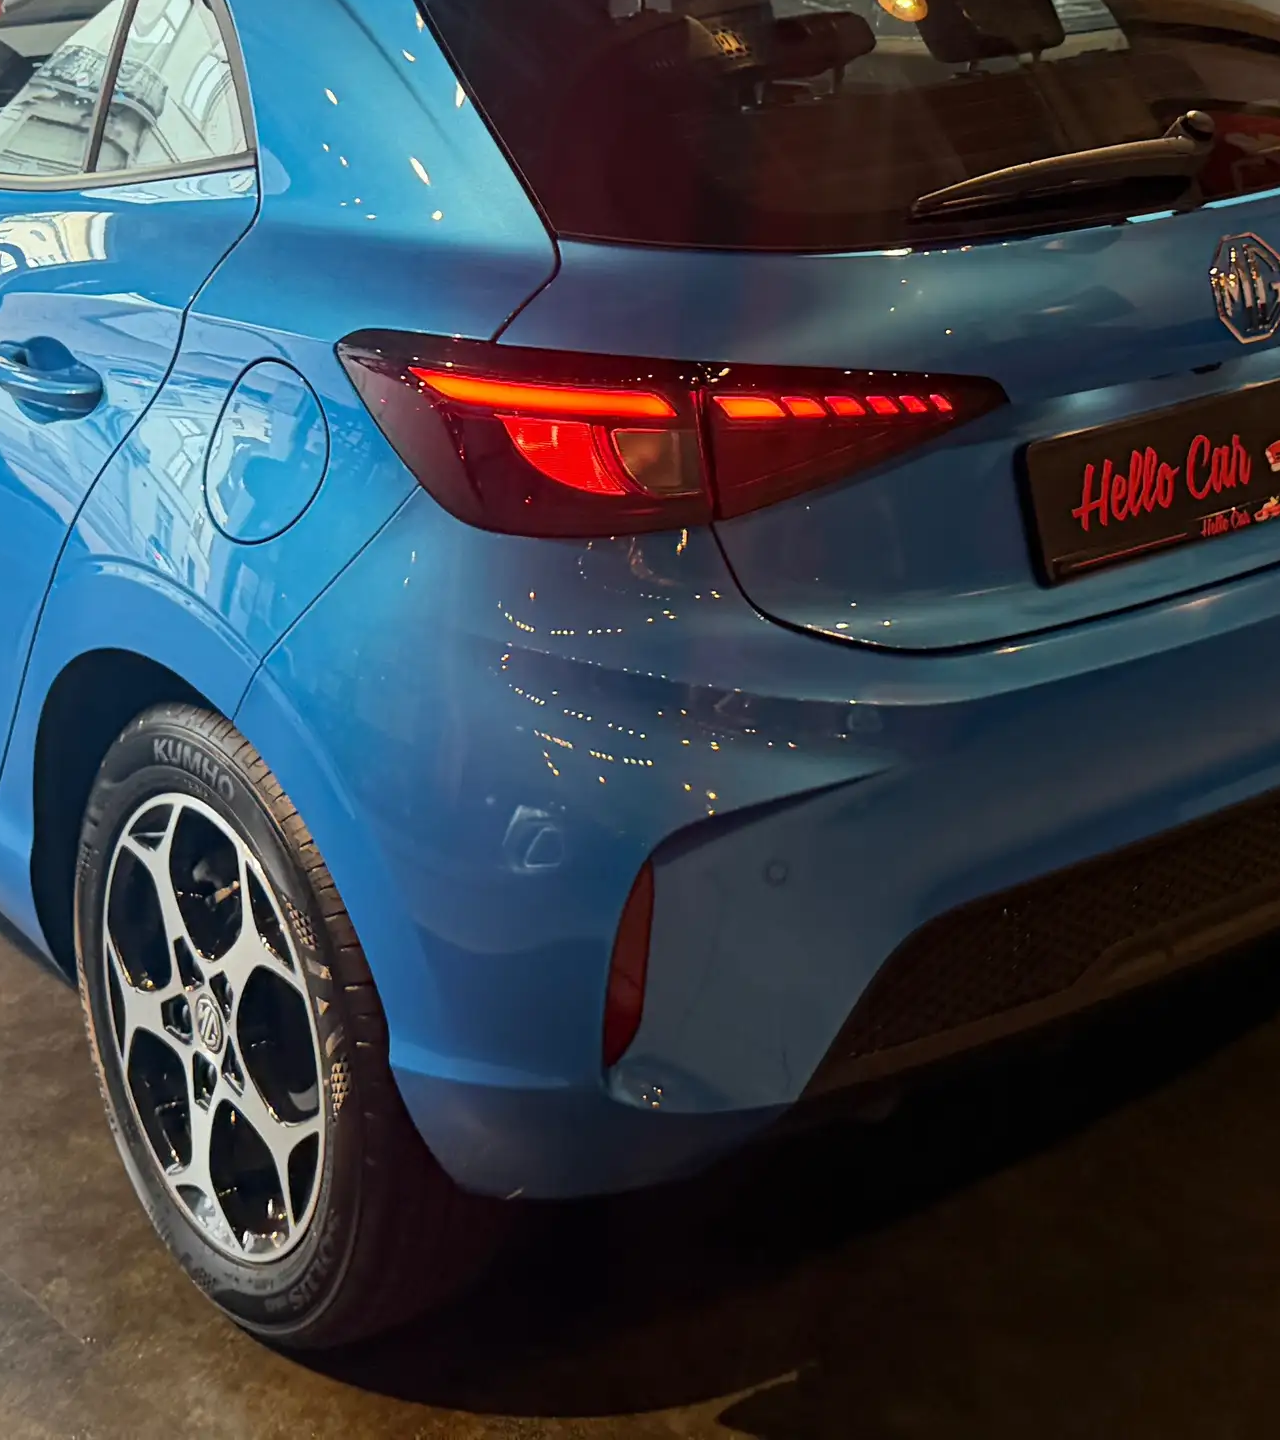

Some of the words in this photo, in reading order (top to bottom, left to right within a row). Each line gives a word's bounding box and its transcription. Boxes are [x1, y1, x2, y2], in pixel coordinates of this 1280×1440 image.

[1071, 445, 1180, 533] Hello
[1185, 433, 1253, 500] Car
[153, 738, 235, 802] KUMHO
